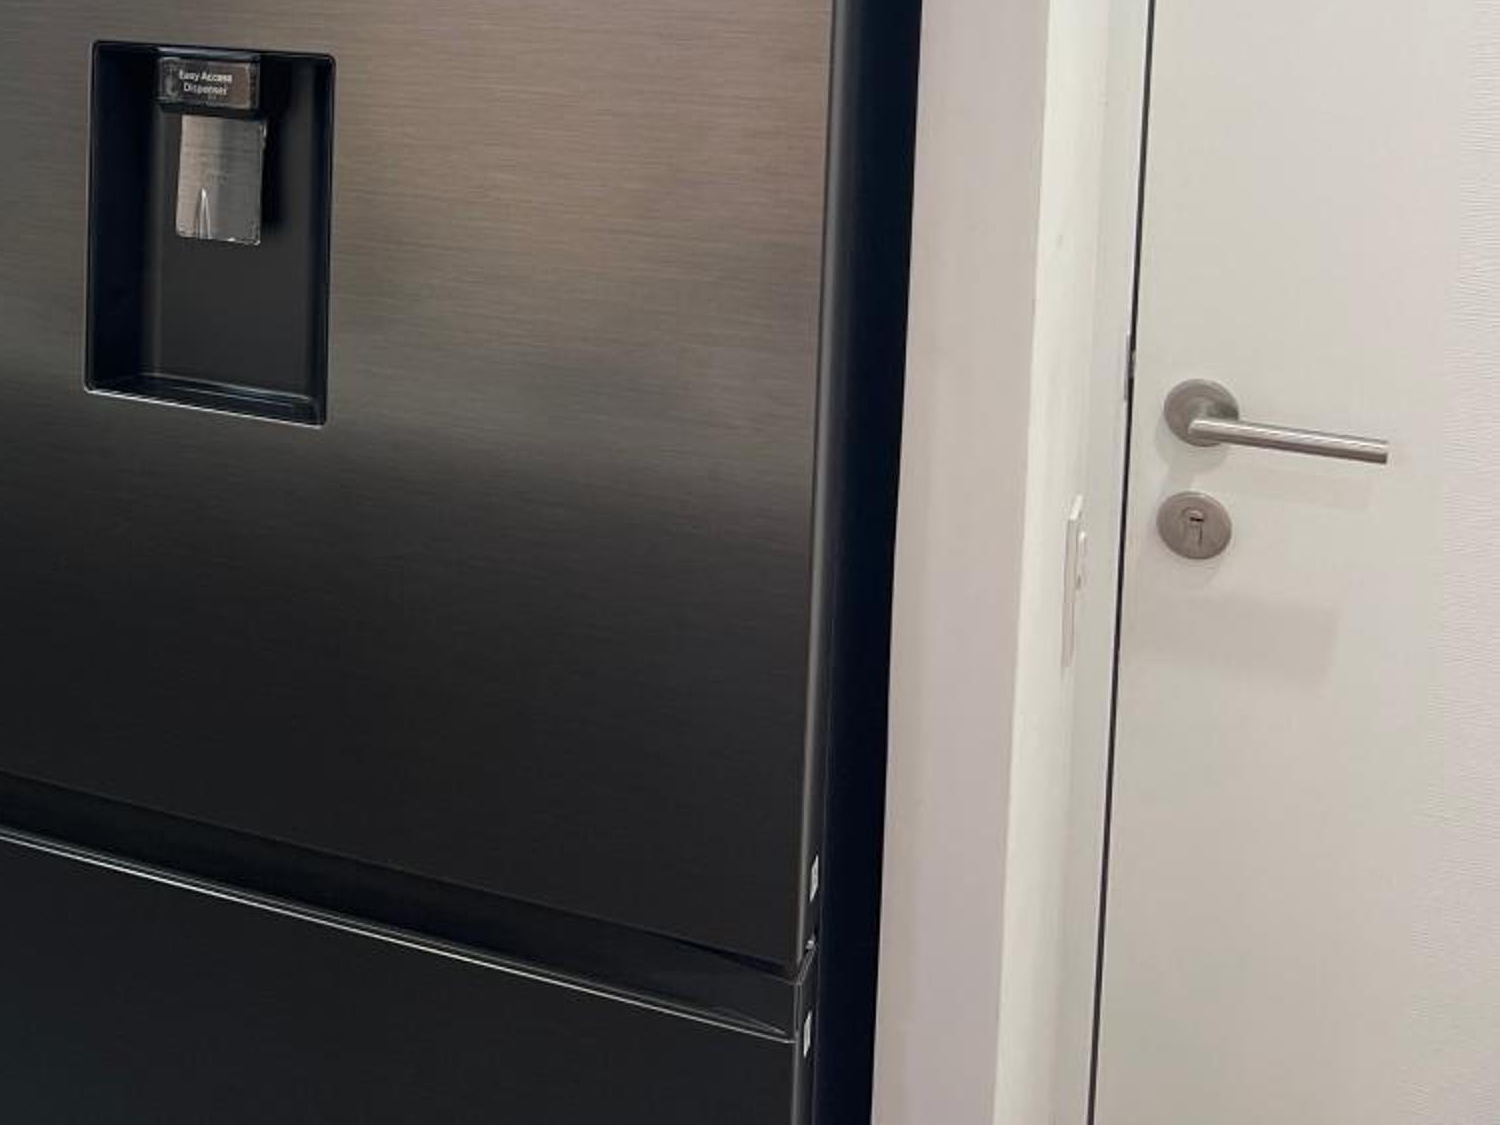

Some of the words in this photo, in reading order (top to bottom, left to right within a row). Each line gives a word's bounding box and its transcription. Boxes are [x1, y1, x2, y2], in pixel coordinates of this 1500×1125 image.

[179, 69, 200, 82] Easy
[201, 71, 233, 84] Access
[183, 82, 228, 96] Dispenser
